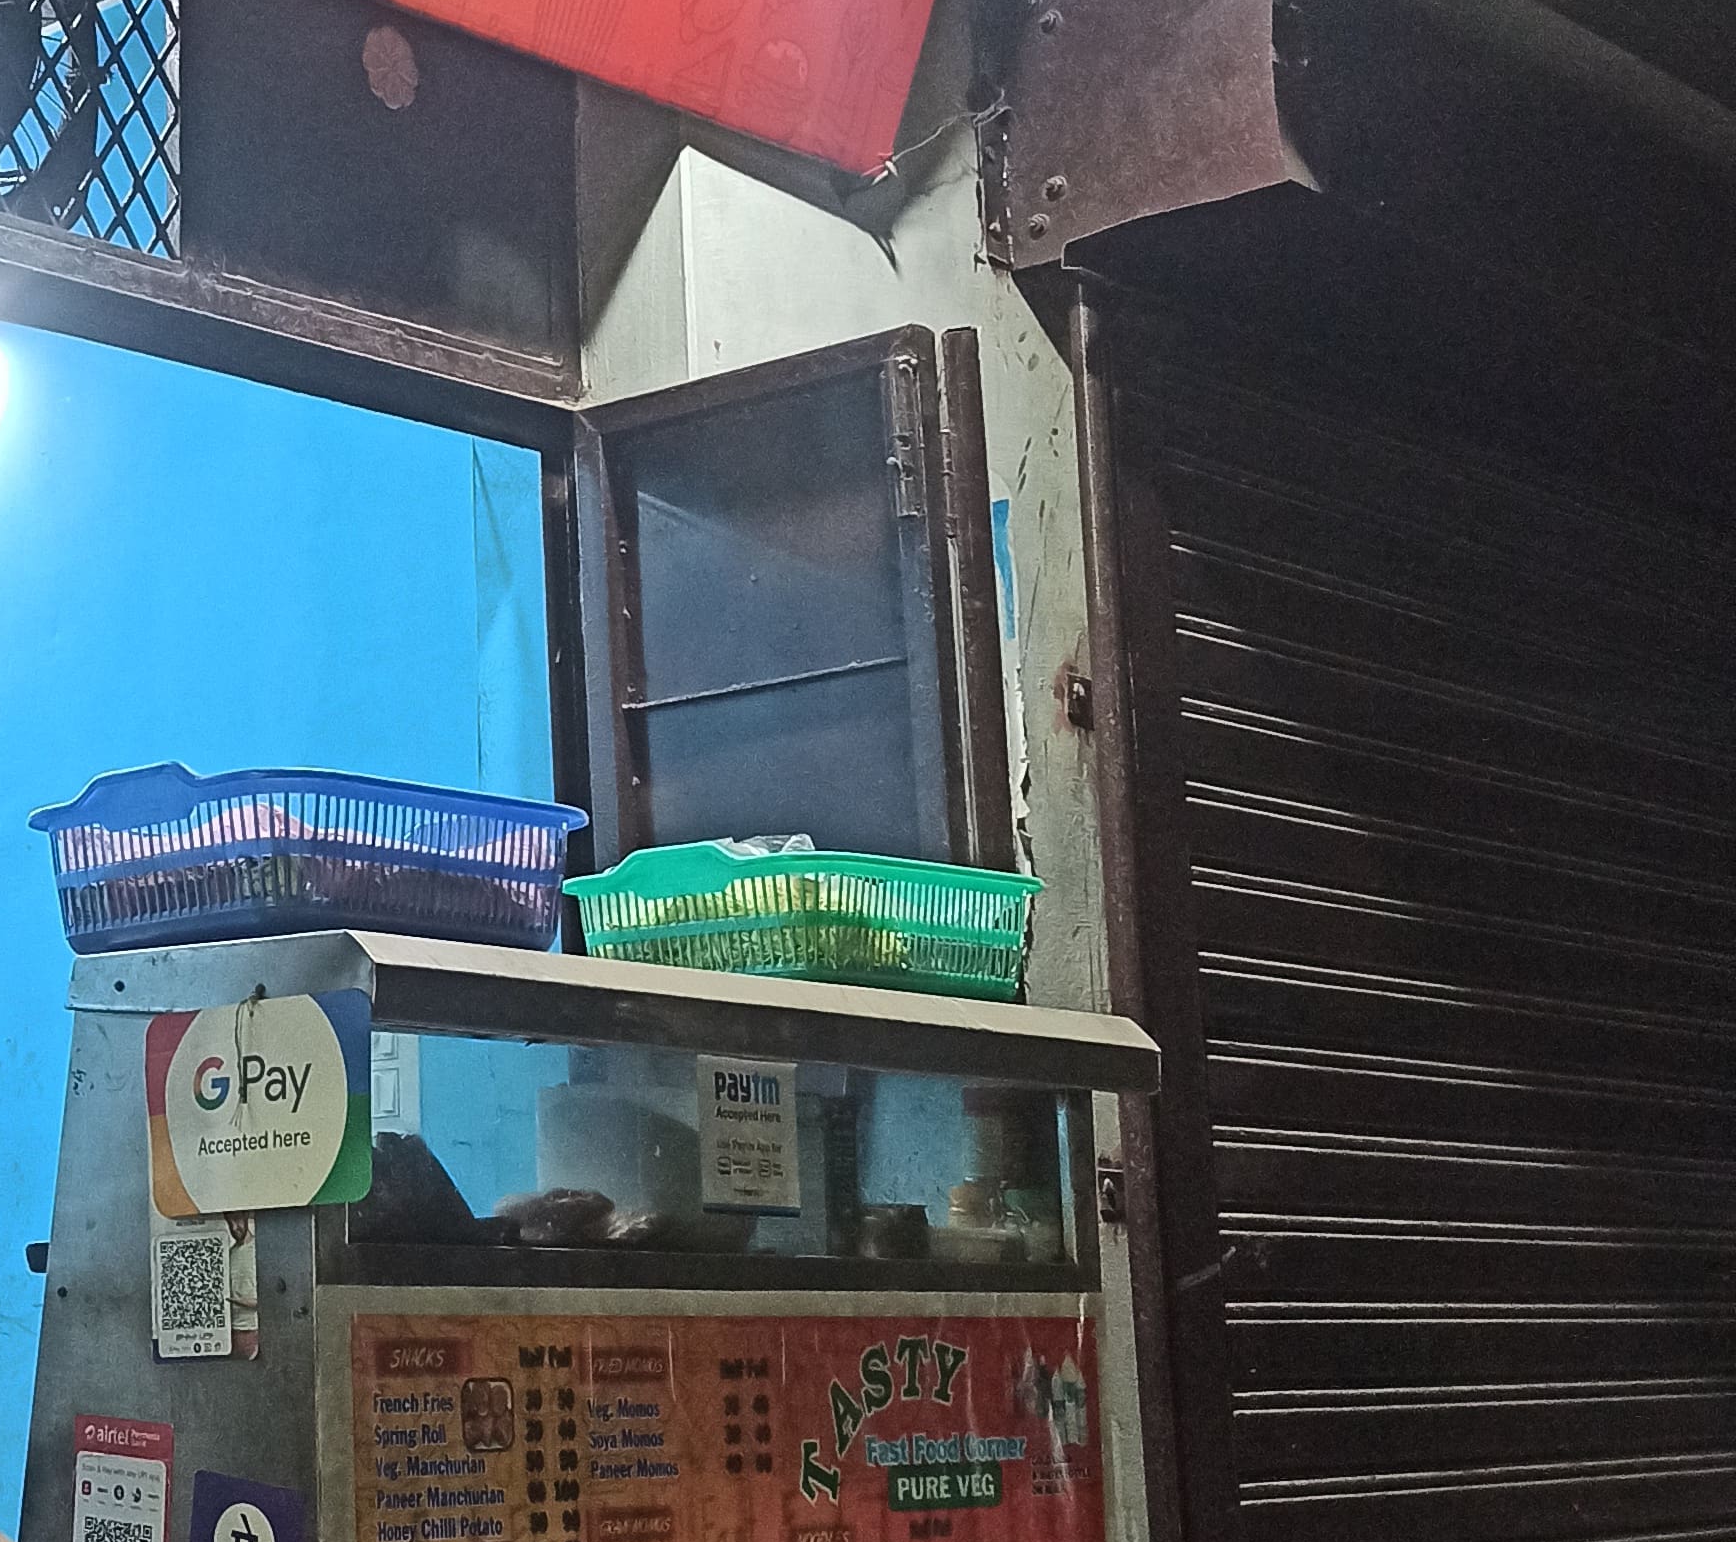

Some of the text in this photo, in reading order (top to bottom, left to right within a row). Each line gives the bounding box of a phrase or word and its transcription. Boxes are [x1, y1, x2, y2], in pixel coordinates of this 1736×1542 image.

[198, 1129, 312, 1157] Accepted here
[373, 1391, 454, 1414] French Fries
[799, 1332, 969, 1507] TASTY
[373, 1423, 447, 1448] Spring Roll
[864, 1434, 911, 1467] Fast
[912, 1432, 960, 1465] Food
[375, 1455, 486, 1481] Veg. Manchurian
[376, 1484, 505, 1510] Paneer Manchurian
[896, 1472, 996, 1502] PURE VEG
[376, 1516, 503, 1542] Honey Chilli Potato
